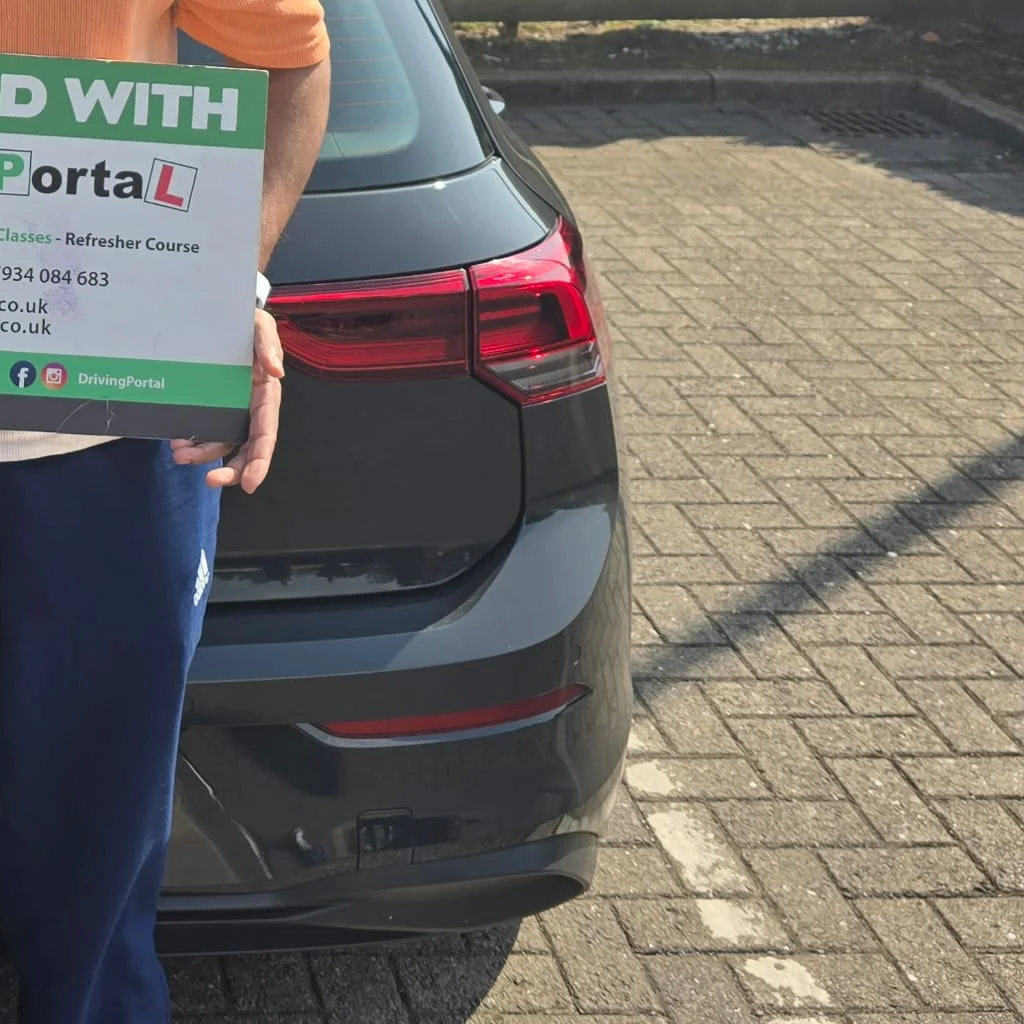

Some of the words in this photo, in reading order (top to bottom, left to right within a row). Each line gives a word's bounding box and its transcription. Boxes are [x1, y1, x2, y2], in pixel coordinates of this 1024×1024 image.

[65, 77, 239, 132] WITH
[65, 231, 142, 250] Refresher
[145, 237, 200, 254] Course
[39, 267, 73, 285] 084
[76, 270, 109, 288] 683
[78, 372, 165, 390] DrivingPortal
